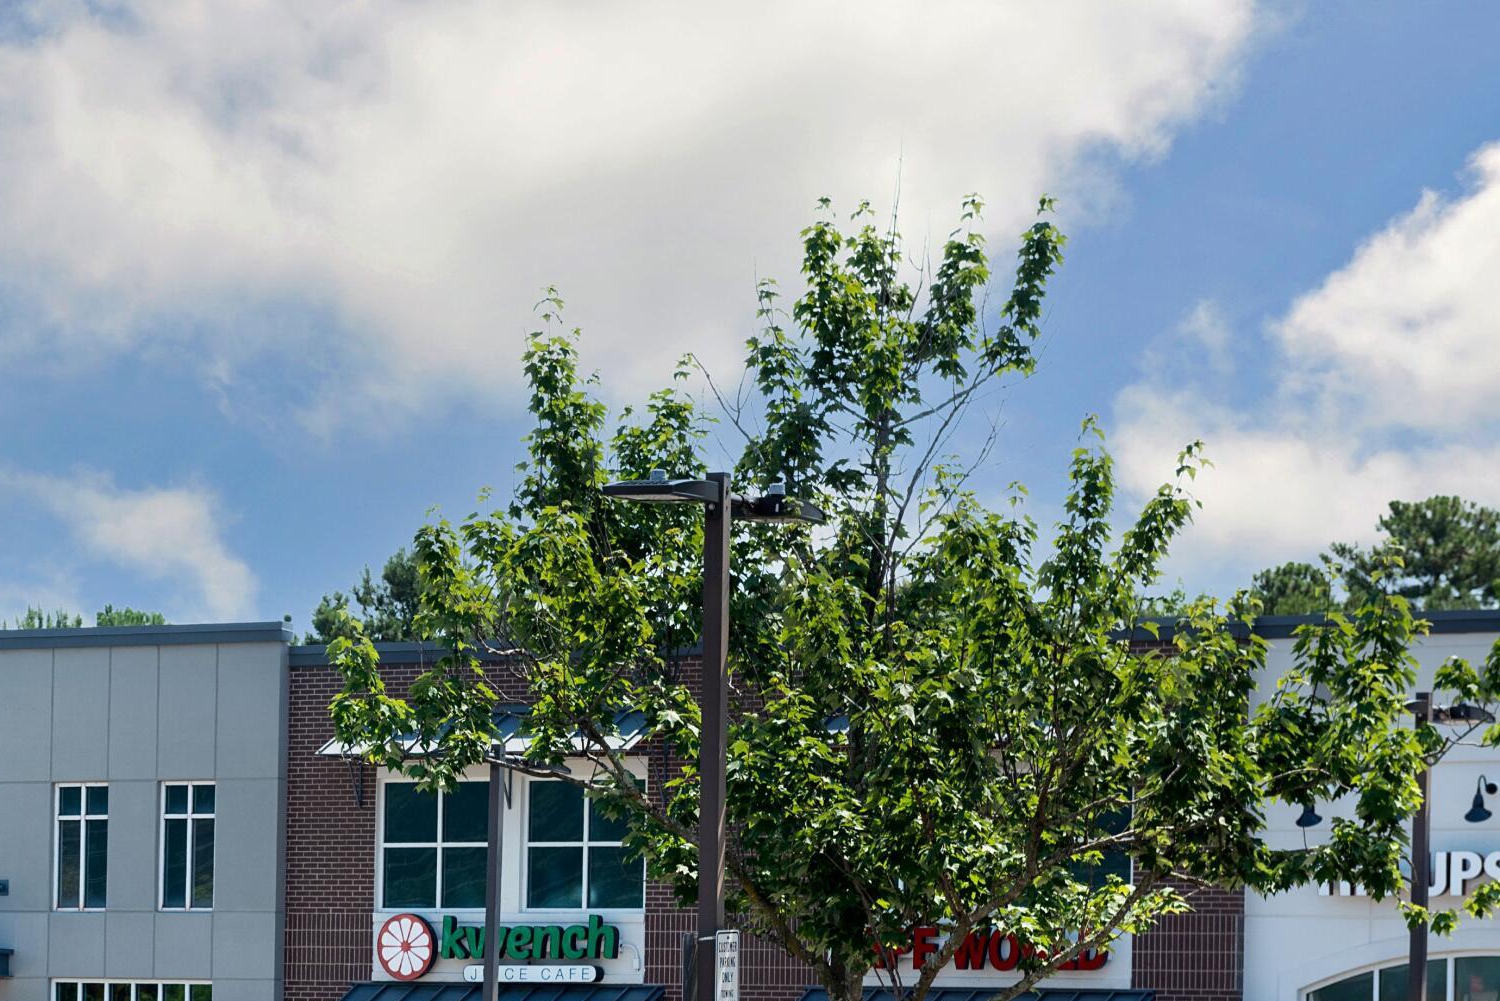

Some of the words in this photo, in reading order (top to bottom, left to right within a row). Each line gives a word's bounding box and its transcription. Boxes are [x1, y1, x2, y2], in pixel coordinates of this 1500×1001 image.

[441, 914, 619, 960] kwench
[719, 941, 737, 953] CUSTOMER
[953, 926, 1109, 971] WOD
[720, 956, 736, 968] PARKING
[470, 967, 528, 981] JCE
[541, 967, 590, 980] CAFE
[722, 971, 733, 983] ONLY
[721, 989, 734, 999] TOWING
